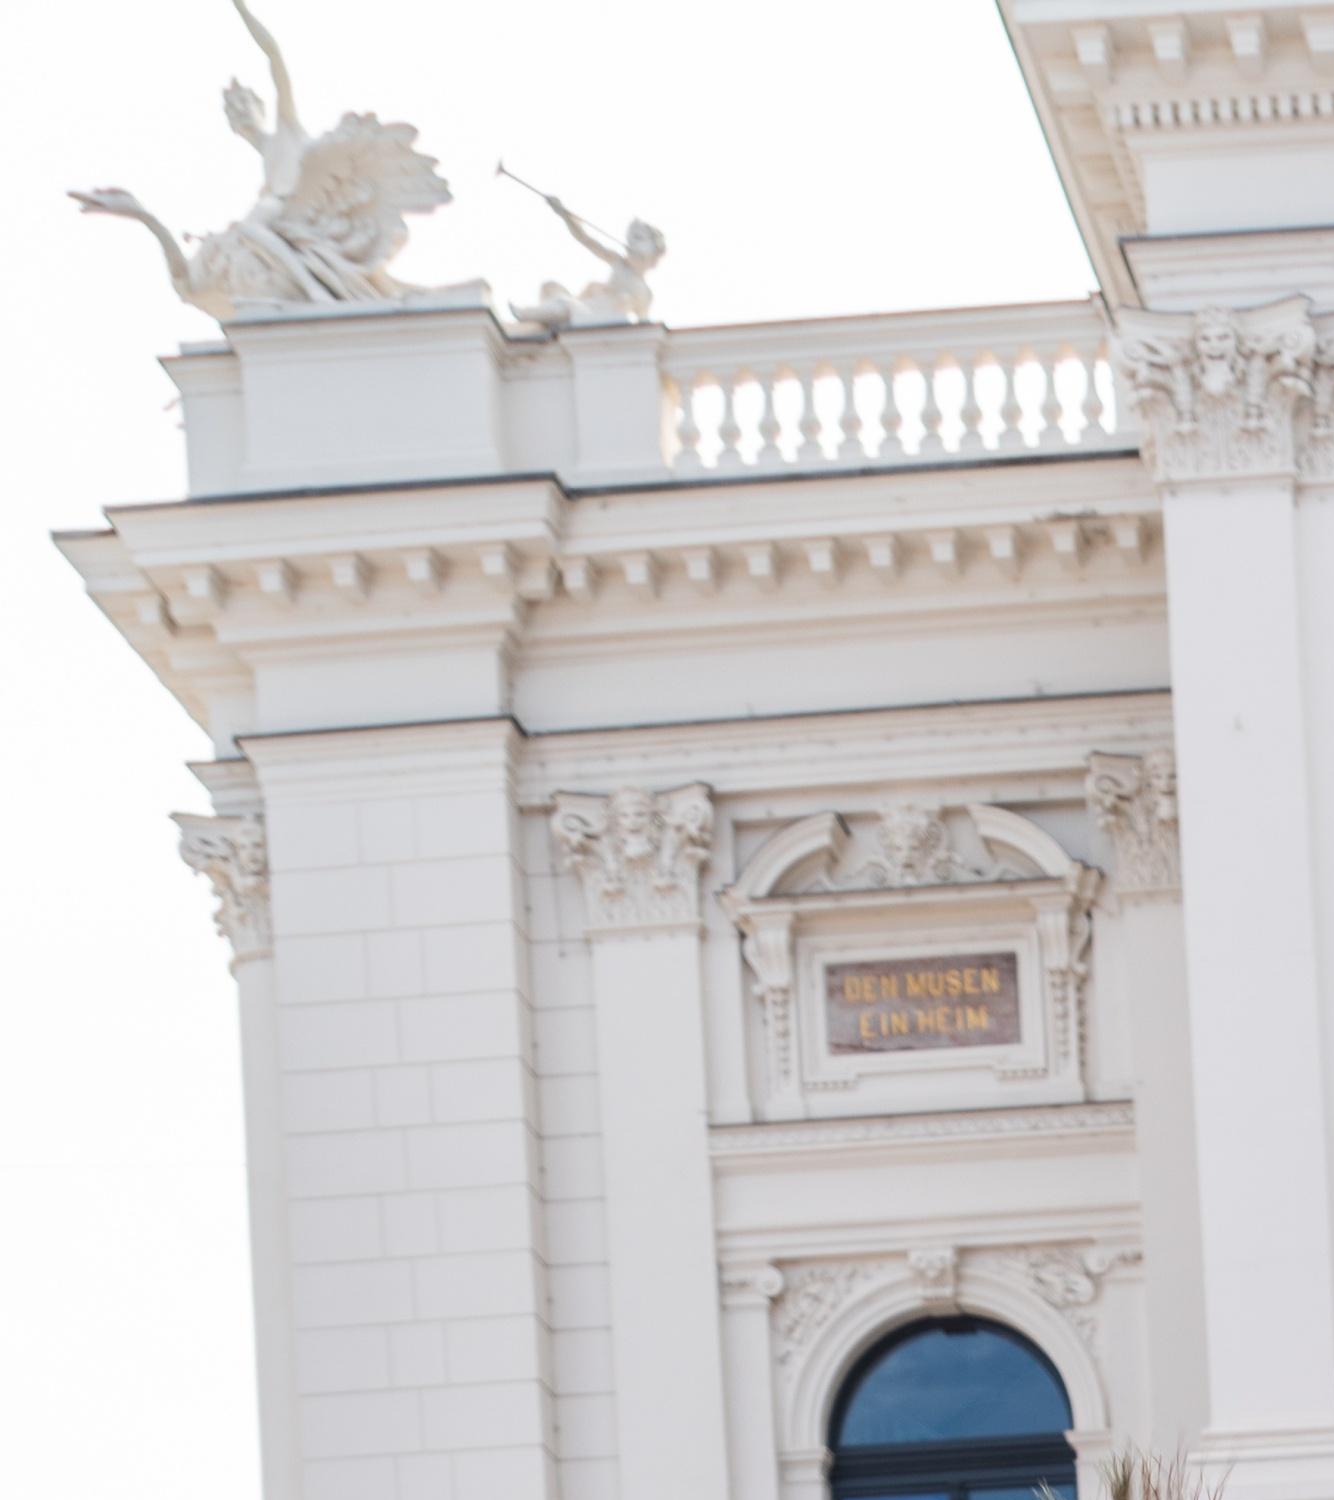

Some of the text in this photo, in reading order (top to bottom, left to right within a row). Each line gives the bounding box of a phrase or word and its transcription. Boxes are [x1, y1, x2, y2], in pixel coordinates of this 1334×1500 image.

[844, 967, 999, 1002] DEN MUSEN
[860, 1004, 989, 1038] EIN HEIM
